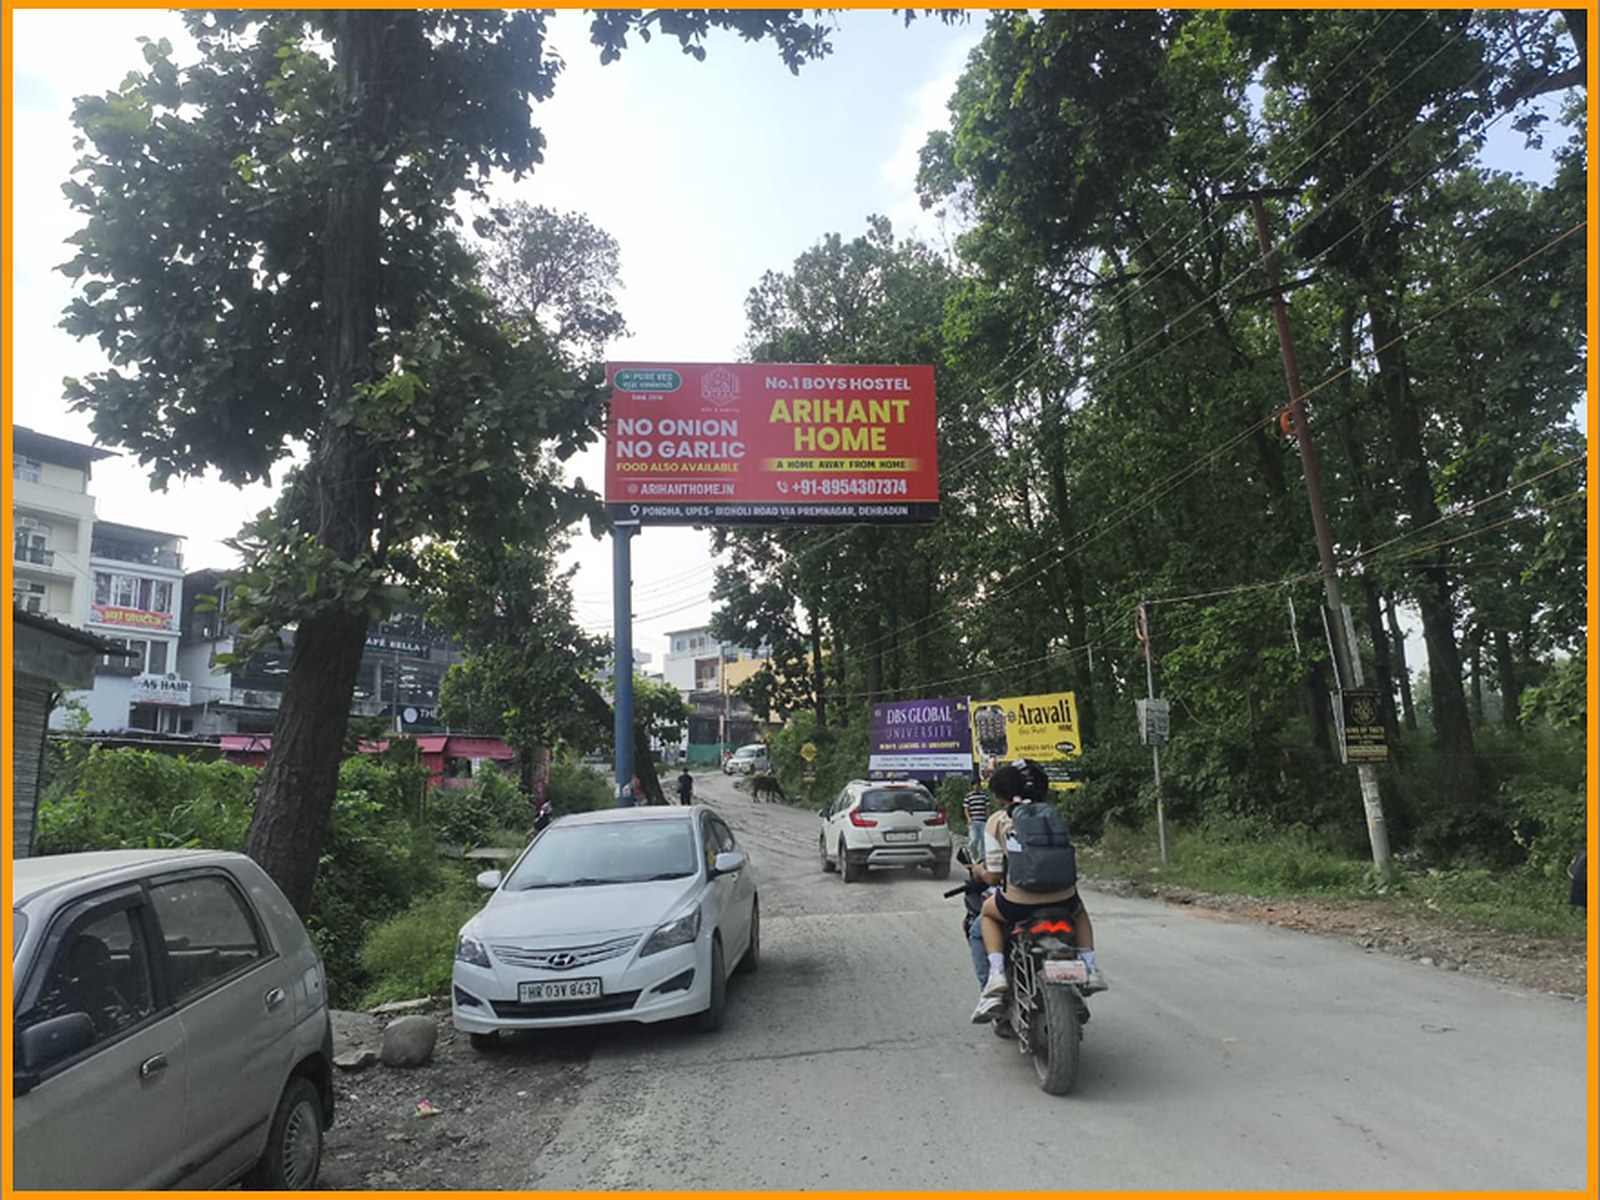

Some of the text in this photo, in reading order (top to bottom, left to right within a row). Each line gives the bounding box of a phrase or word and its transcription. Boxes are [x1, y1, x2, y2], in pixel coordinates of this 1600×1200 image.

[765, 377, 911, 391] No.1 BOYS HOSTEL
[769, 399, 910, 424] ARIHANT
[617, 418, 738, 436] NO ONION
[794, 426, 887, 451] HOME
[617, 441, 746, 459] NO GARLIC
[616, 462, 740, 472] FOOD ALSO AVAILABLE
[777, 460, 906, 469] A HOME AWAY FROM HOME
[640, 483, 735, 495] ARIHANTHOME.IN
[792, 479, 908, 495] +91-8954307374
[642, 506, 683, 517] PONDHA,
[715, 506, 751, 516] BIDHOLI
[753, 506, 779, 516] ROAD
[780, 506, 798, 516] VIA
[858, 506, 908, 516] DEHRADUN
[389, 641, 420, 651] BELLA
[160, 680, 188, 692] HAIR
[886, 705, 952, 725] DBS GLOBAL
[1018, 699, 1072, 725] Aravali
[886, 725, 952, 739] UNIVERSITY
[528, 985, 543, 999] HR
[569, 981, 598, 997] 8437
